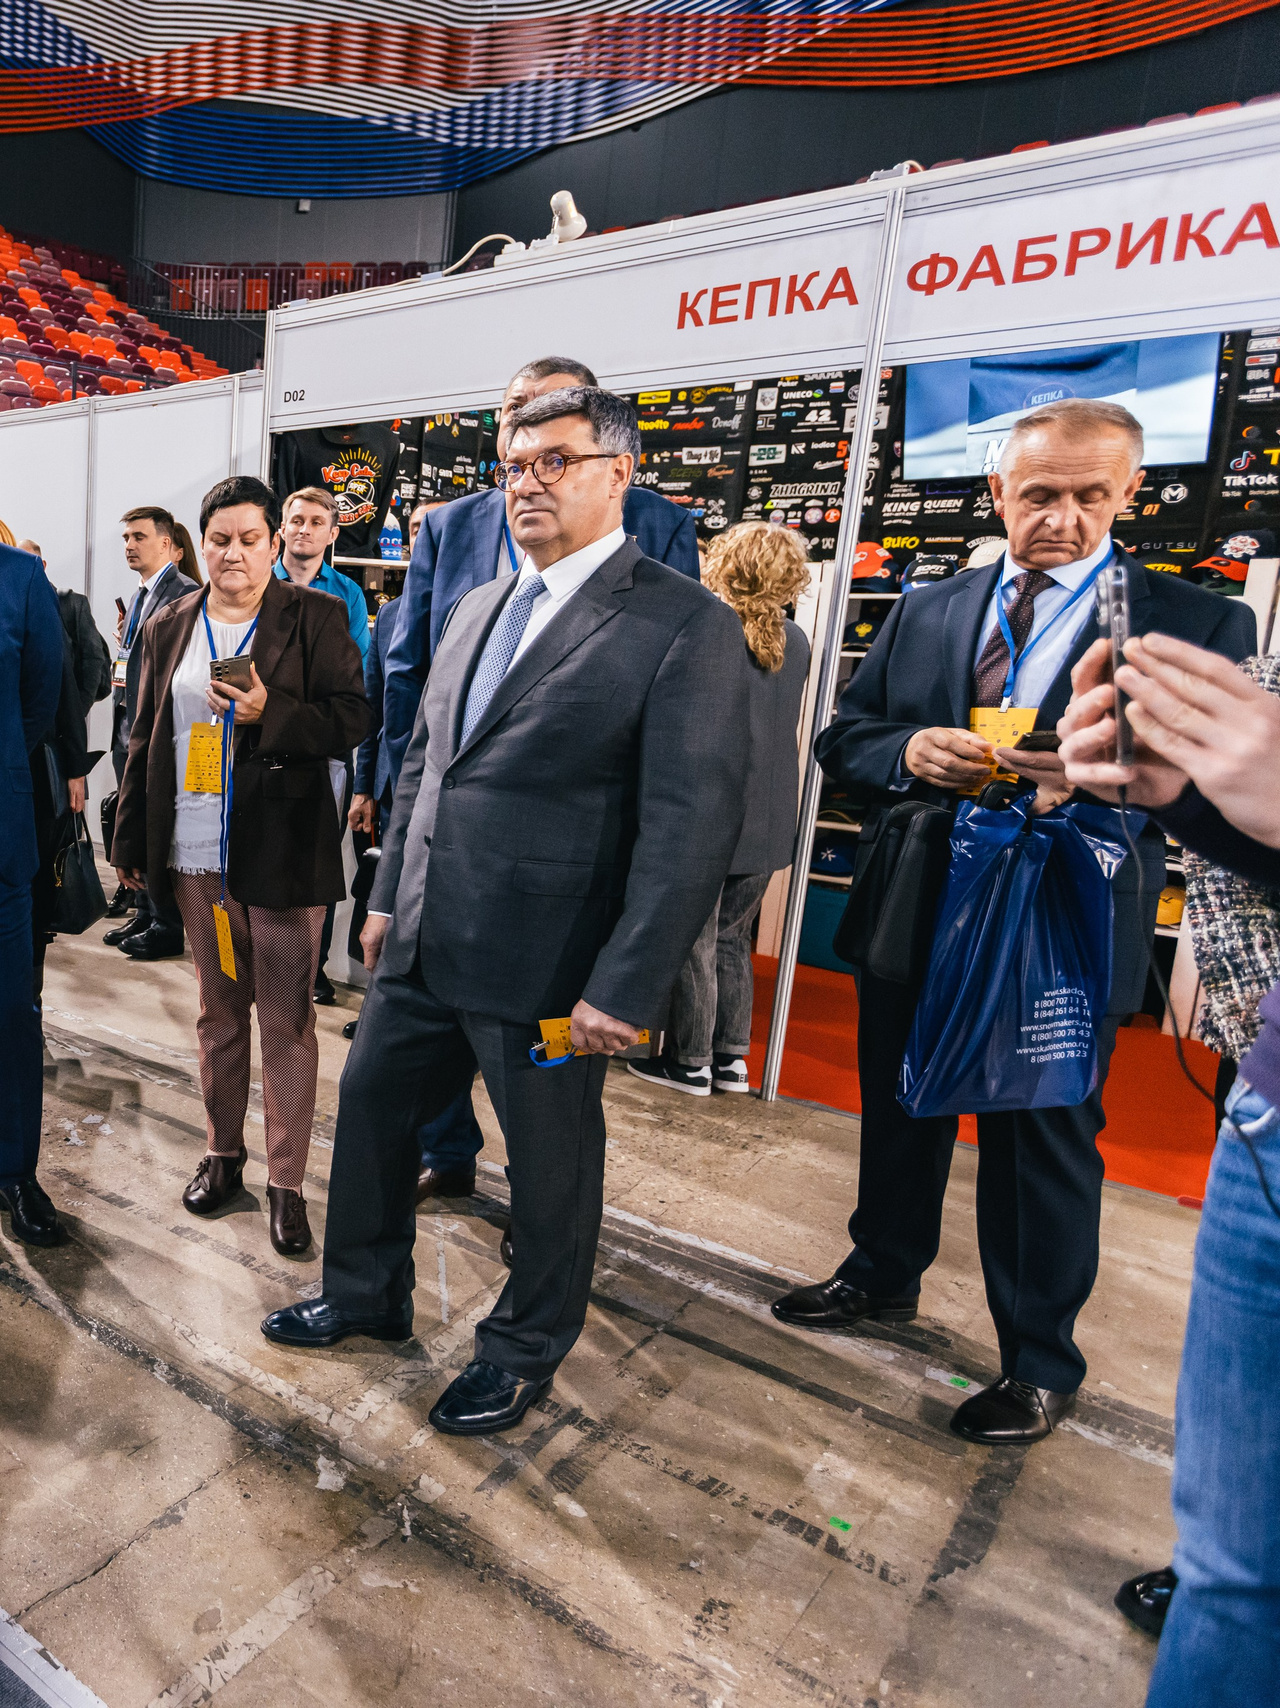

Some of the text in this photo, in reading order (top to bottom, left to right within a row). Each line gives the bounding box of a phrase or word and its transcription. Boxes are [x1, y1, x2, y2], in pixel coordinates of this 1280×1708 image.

[675, 201, 1280, 330] КЕПКА ФАБРИКА
[284, 389, 305, 403] D02
[782, 390, 813, 400] UNECO
[1031, 389, 1063, 405] КЕПКА
[805, 409, 832, 422] 42
[321, 465, 350, 483] Keep
[1223, 473, 1279, 487] TikTok
[769, 481, 841, 498] ZHAGRINA
[882, 501, 922, 513] KING
[923, 498, 964, 509] QUEEN
[882, 536, 920, 549] BUFO
[1141, 541, 1198, 550] GUTSU
[1055, 1007, 1067, 1015] 261
[1053, 1029, 1066, 1038] 500
[1078, 1029, 1091, 1038] 43
[1052, 1051, 1065, 1060] 500
[1066, 1050, 1075, 1058] 78
[1075, 1049, 1087, 1057] 23
